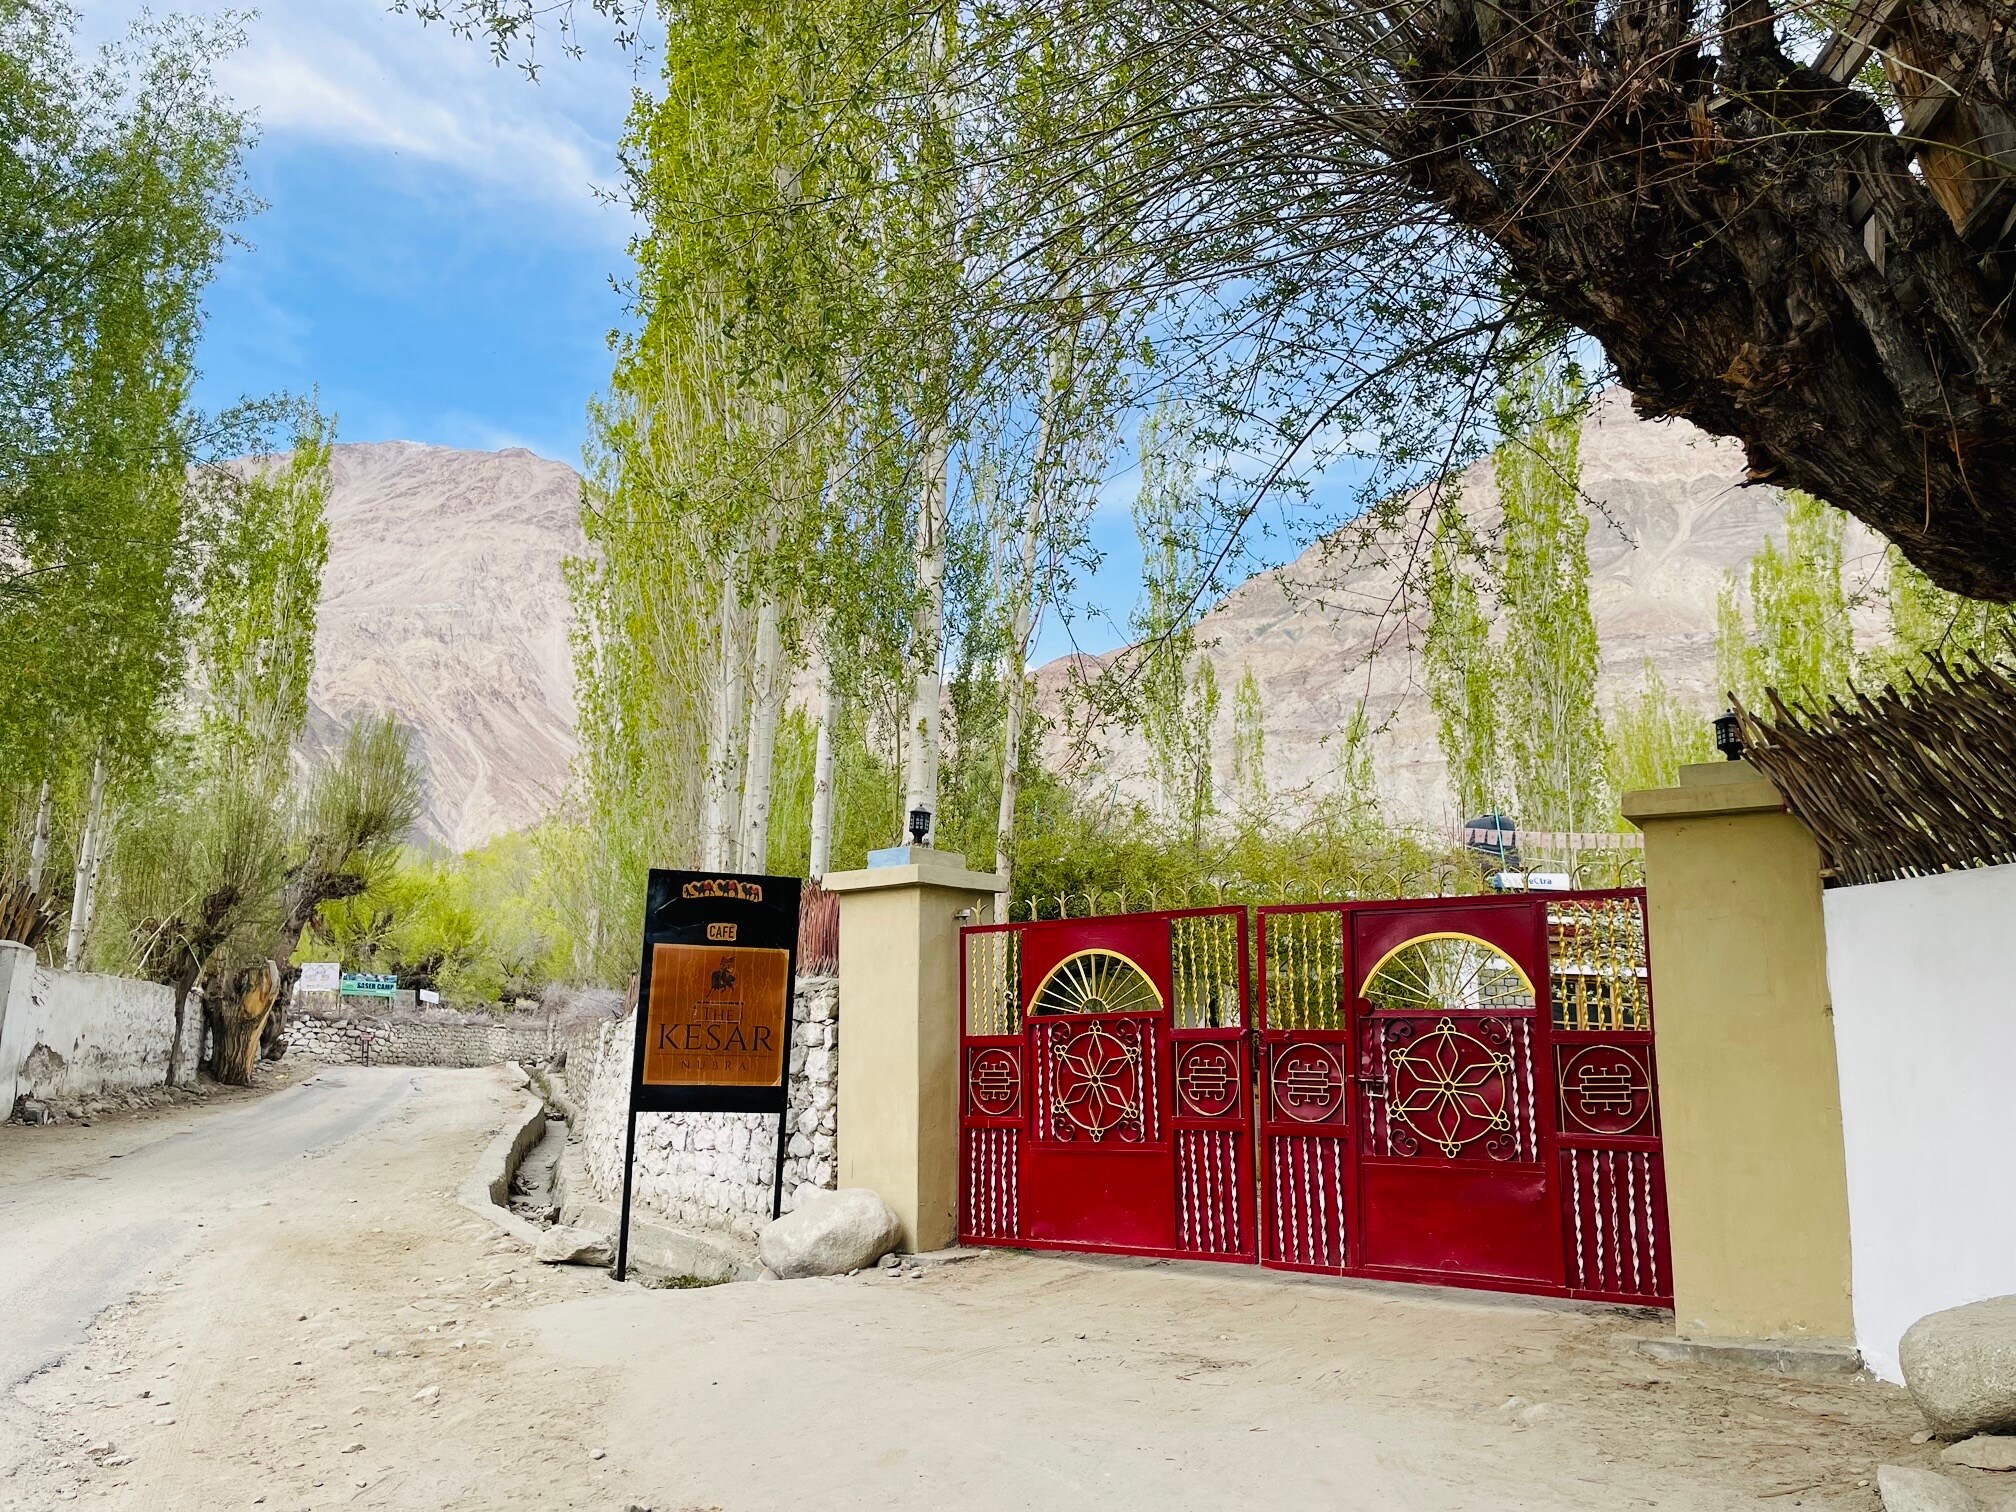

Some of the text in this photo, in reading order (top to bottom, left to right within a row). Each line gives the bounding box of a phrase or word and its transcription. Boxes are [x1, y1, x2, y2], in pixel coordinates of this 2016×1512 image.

[709, 925, 735, 939] CAFE
[357, 982, 394, 991] SASER CAMP
[702, 1007, 734, 1021] THE
[658, 1023, 774, 1052] KESAR
[681, 1061, 747, 1071] NUBRA
